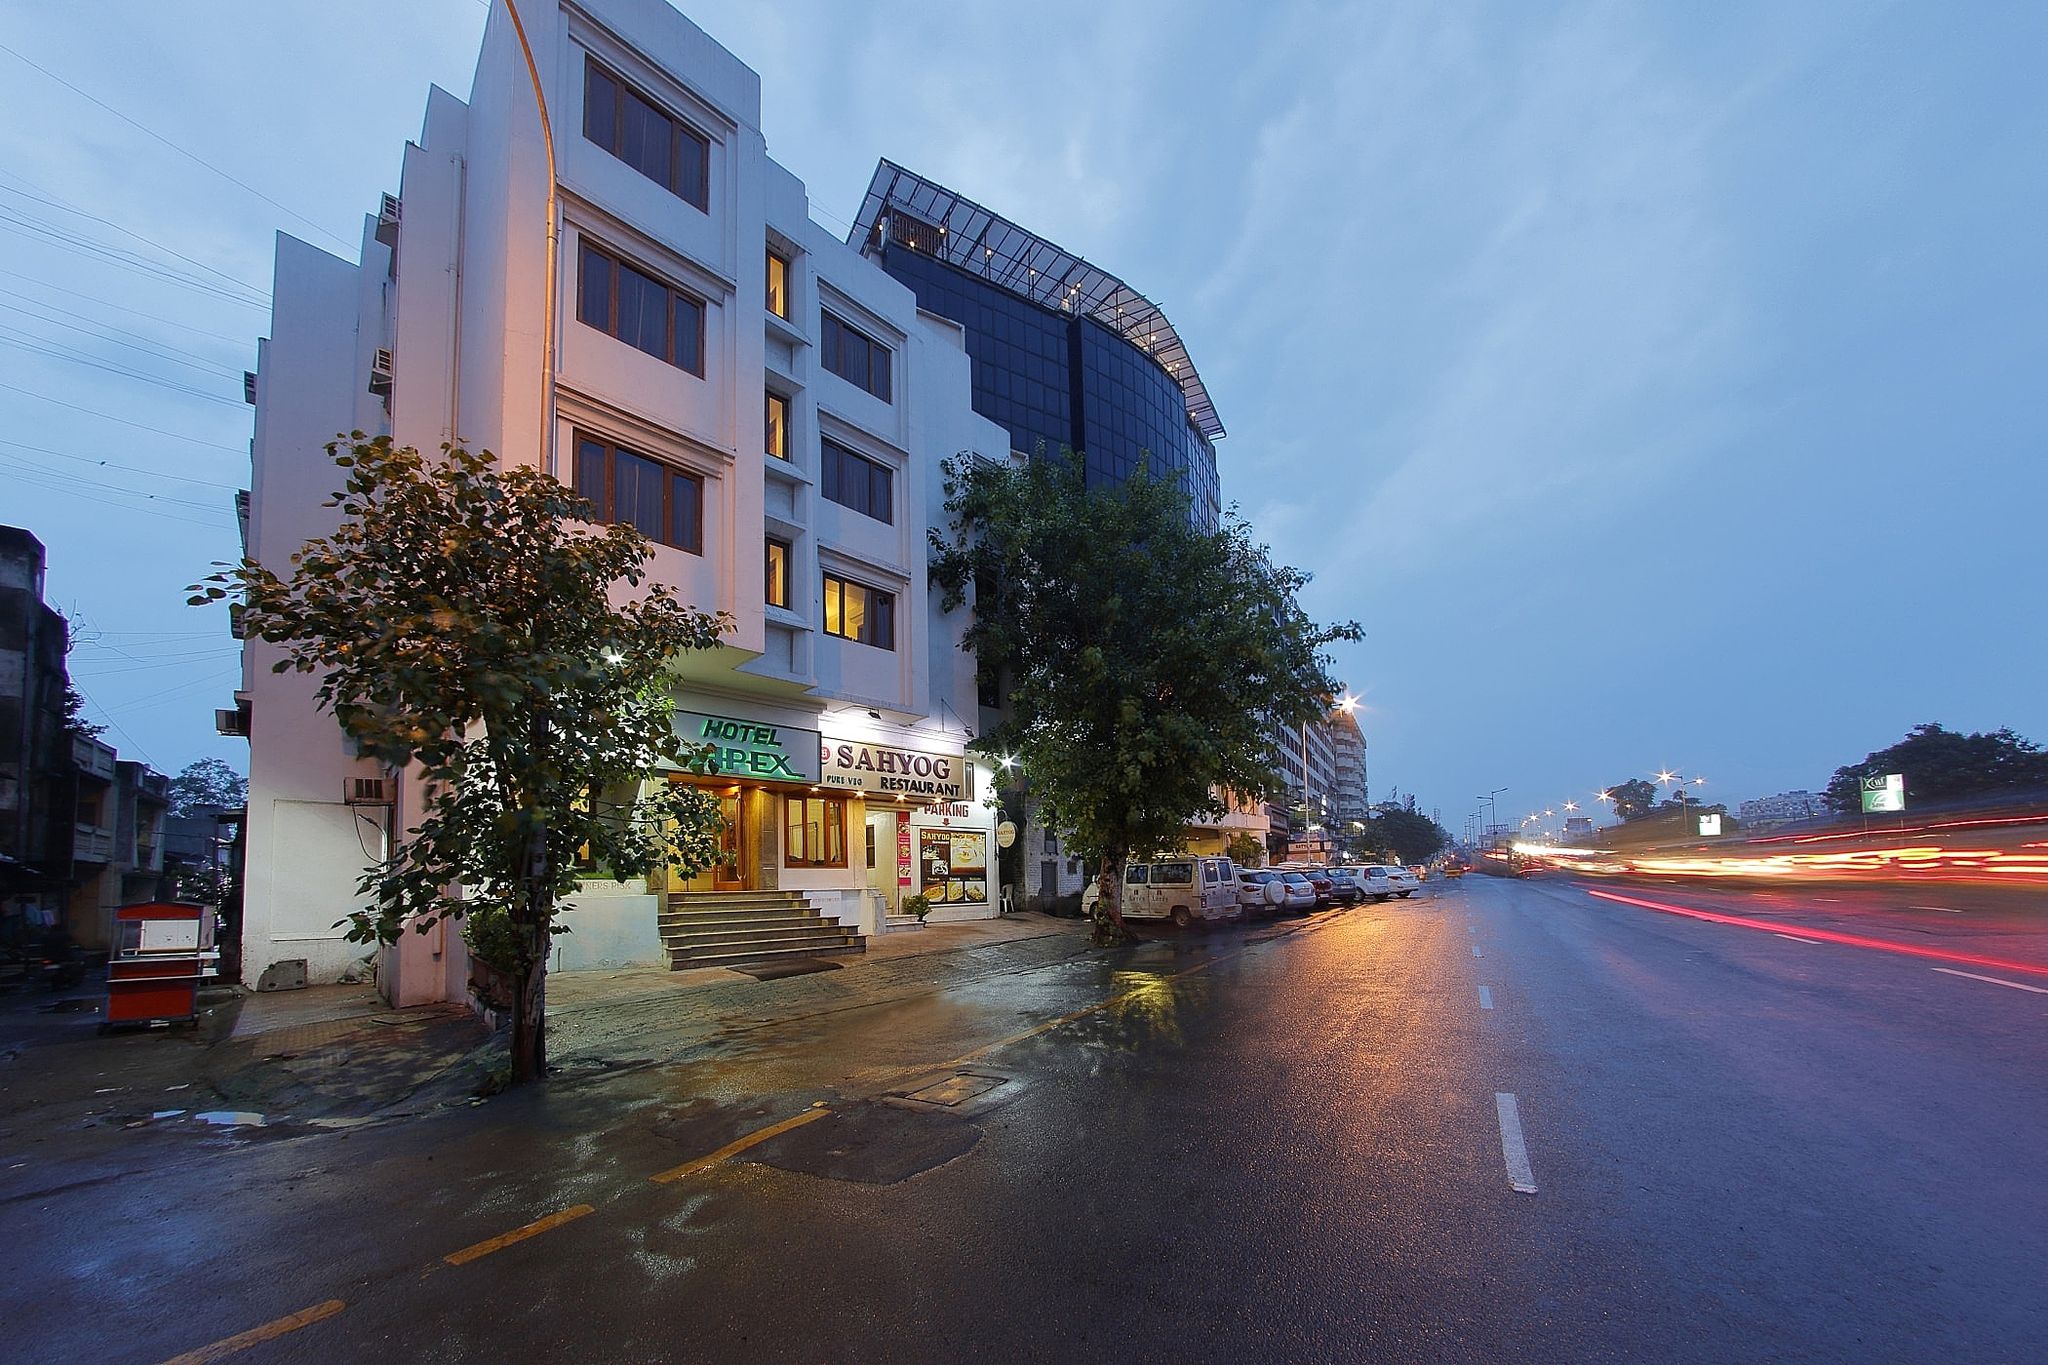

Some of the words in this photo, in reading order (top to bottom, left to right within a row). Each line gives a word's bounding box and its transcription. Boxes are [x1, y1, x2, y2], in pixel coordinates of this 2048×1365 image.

[702, 719, 783, 747] HOTEL
[837, 744, 951, 780] SAHYOG
[826, 775, 845, 785] PURE
[880, 776, 960, 797] RESTAURANT
[924, 803, 969, 817] PARKING
